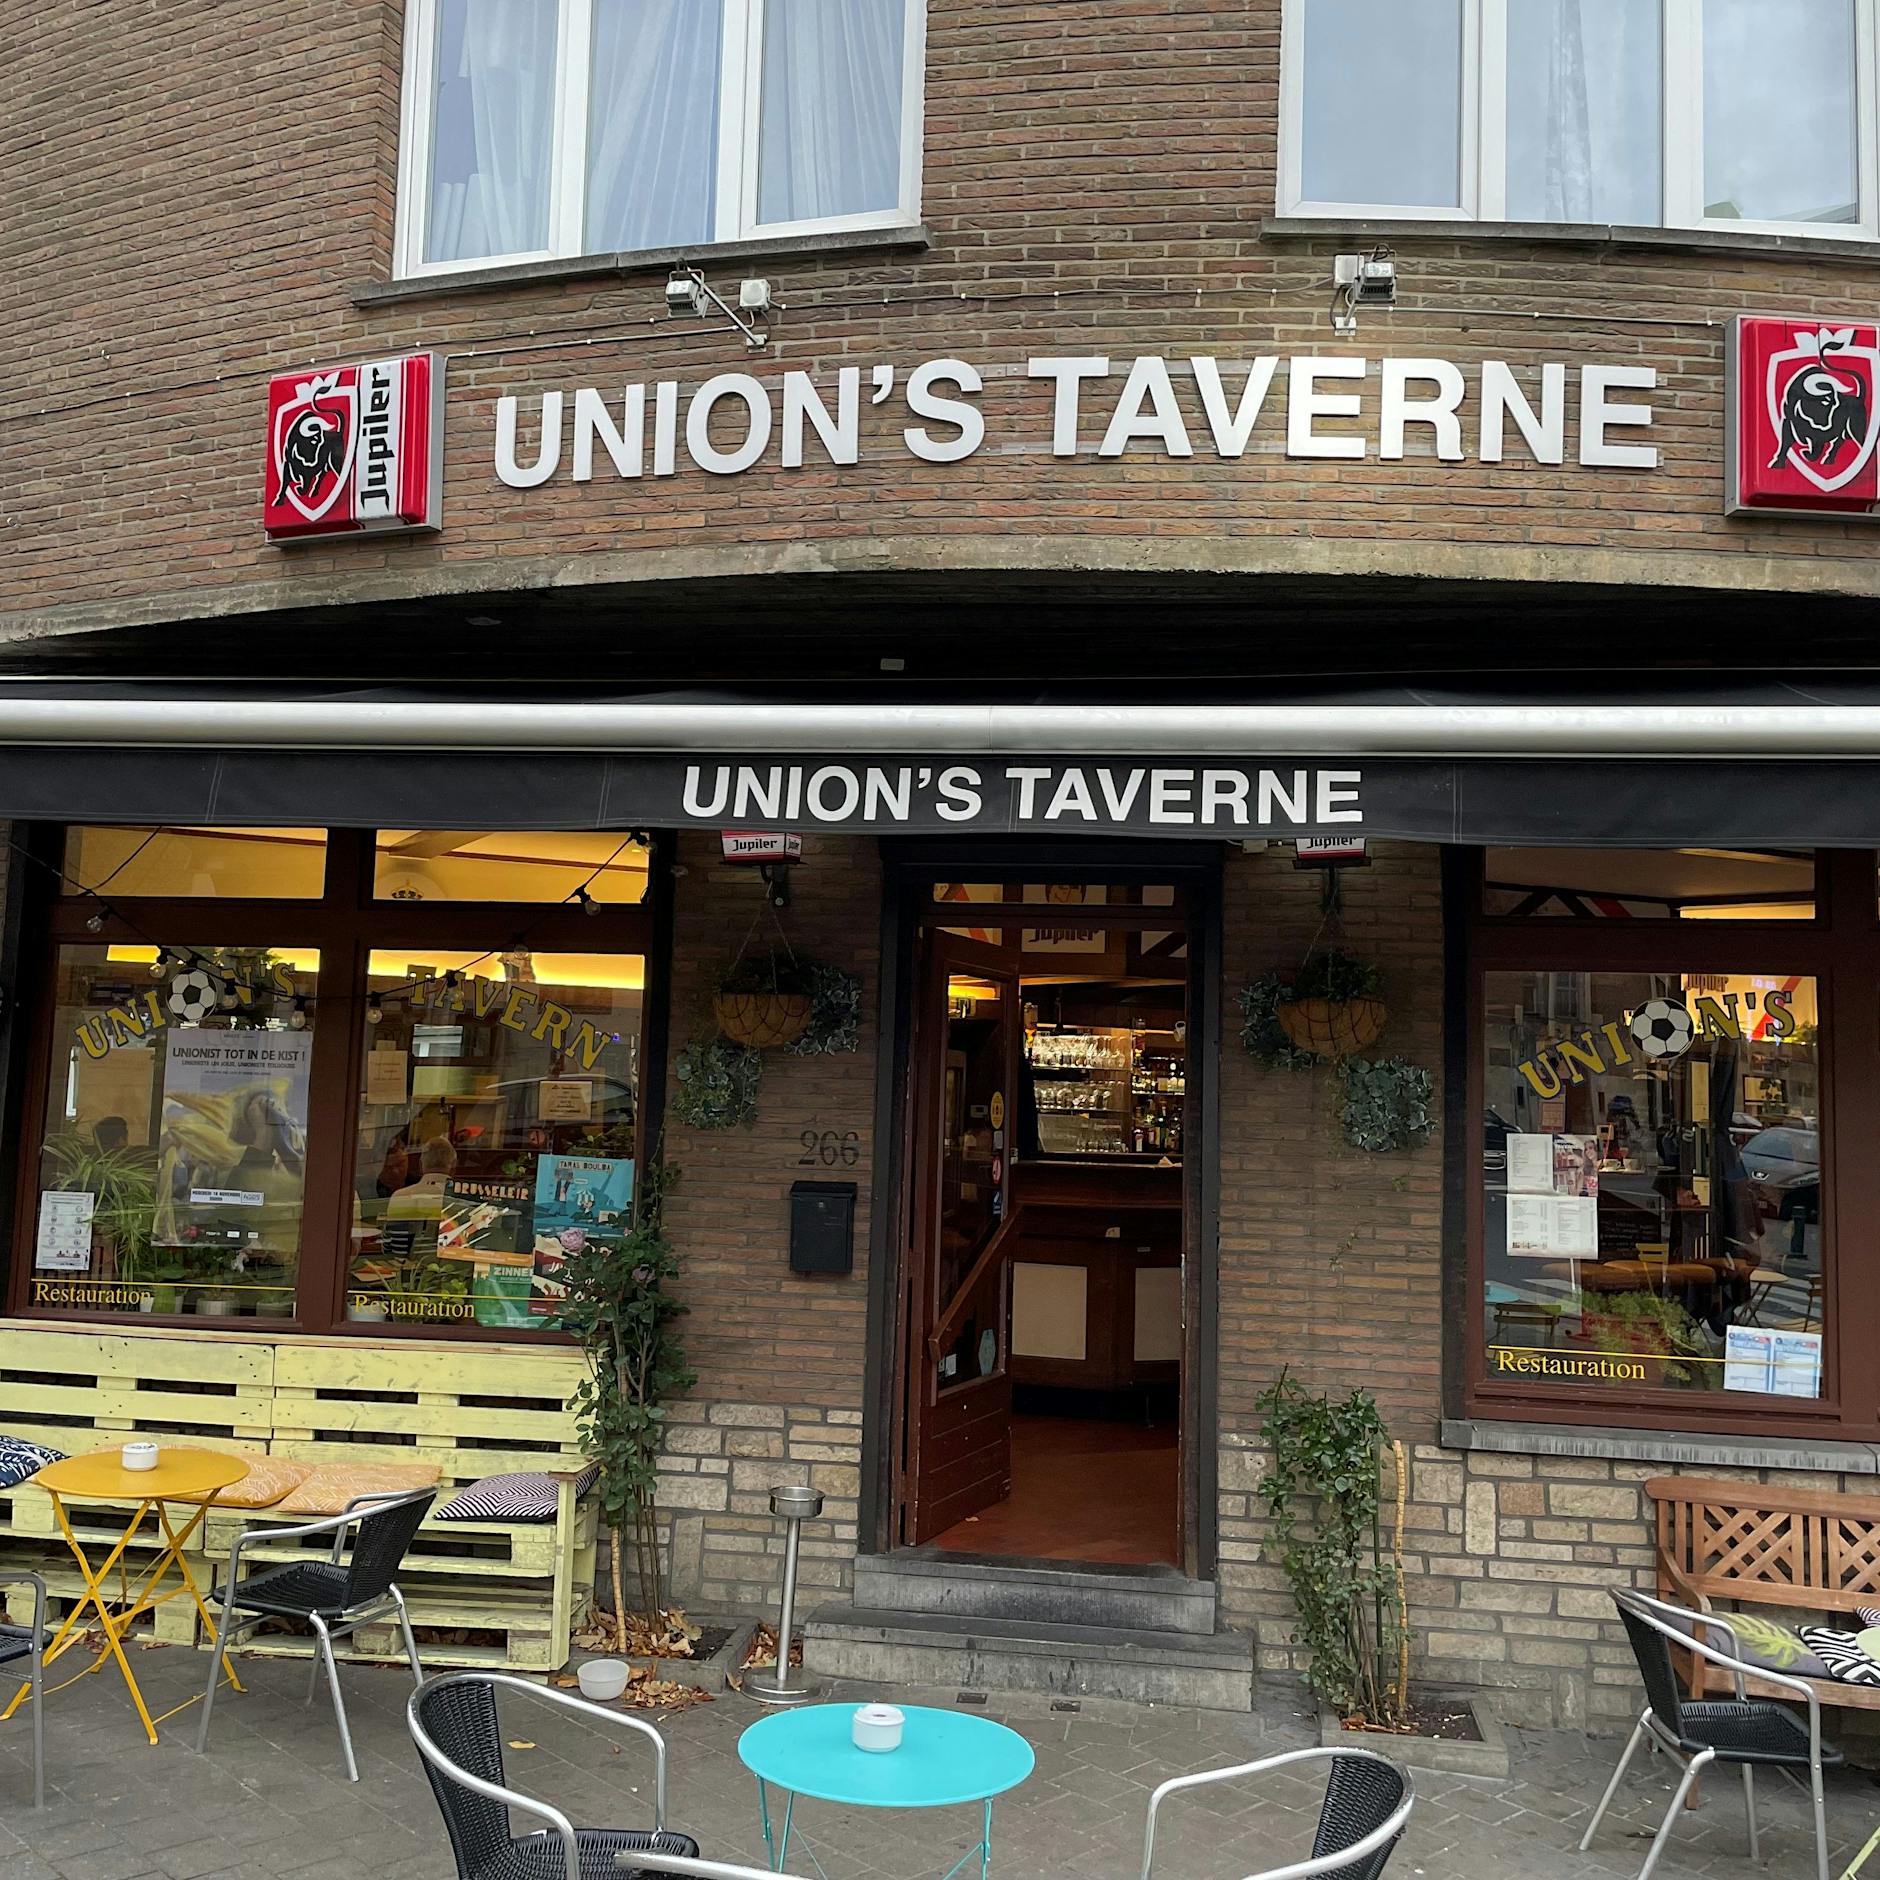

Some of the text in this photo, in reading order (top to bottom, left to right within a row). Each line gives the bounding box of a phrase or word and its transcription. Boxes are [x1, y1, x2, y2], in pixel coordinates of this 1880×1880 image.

[359, 367, 392, 510] Jupiler
[495, 356, 1657, 488] UNION'S TAVERNE
[682, 766, 1364, 824] UNION'S TAVERNE
[732, 838, 778, 851] Jupiler
[406, 964, 613, 1071] TAVERN
[172, 1047, 221, 1058] UNIONIST
[224, 1049, 245, 1059] TOT
[247, 1049, 258, 1060] IN
[261, 1050, 275, 1060] DE
[278, 1050, 298, 1061] KIST
[799, 1130, 859, 1166] 266
[34, 1281, 152, 1305] Restauration
[354, 1294, 475, 1318] Restauration
[1497, 1350, 1646, 1380] Restauration
